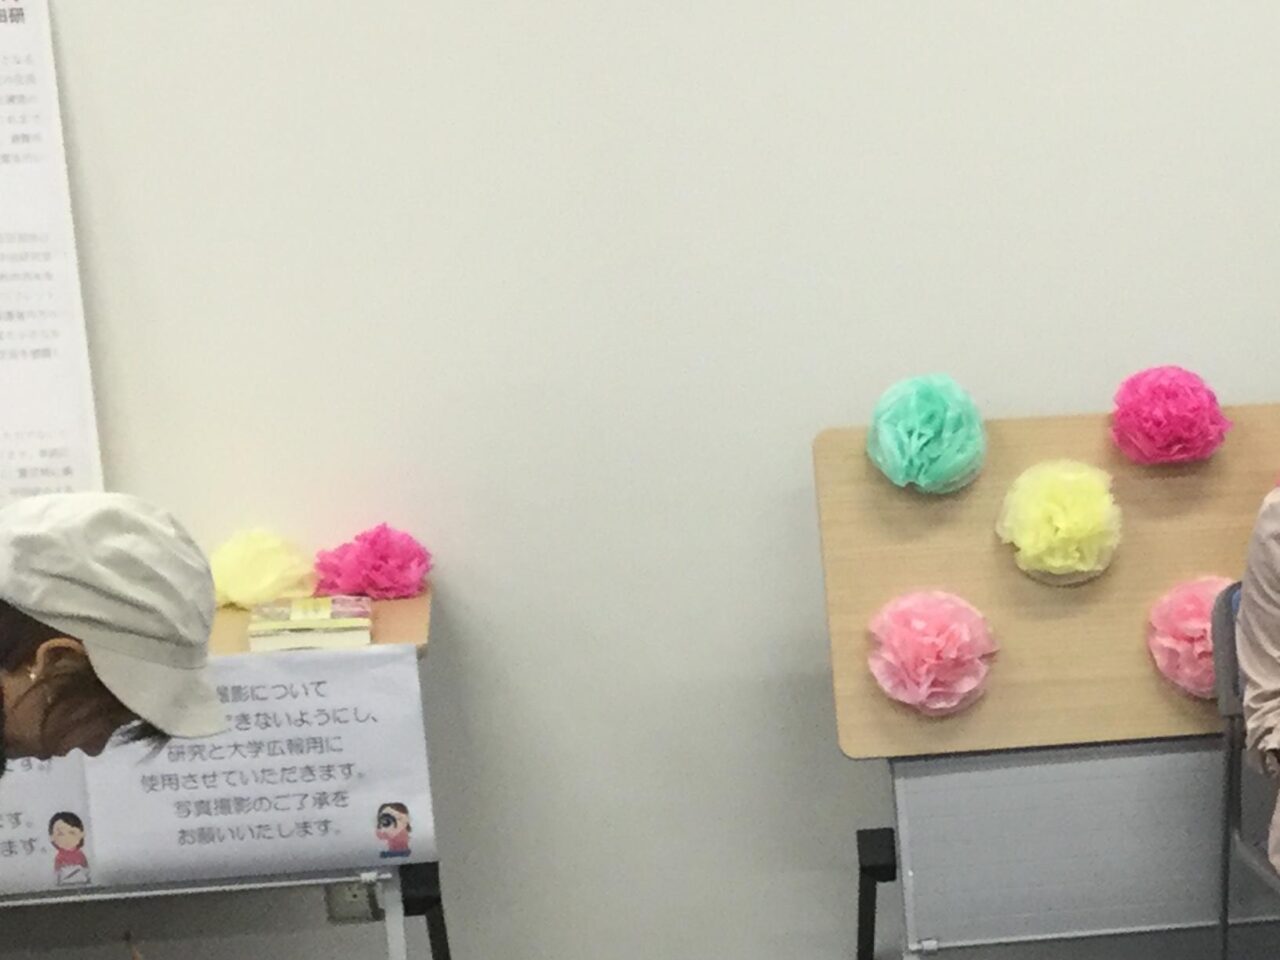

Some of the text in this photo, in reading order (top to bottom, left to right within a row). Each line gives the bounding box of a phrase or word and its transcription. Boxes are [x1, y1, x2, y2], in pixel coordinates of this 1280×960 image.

[167, 736, 344, 763] 研究と大学広報用に
[140, 762, 366, 794] 使用させていただきます。
[173, 790, 351, 818] 写真撮影のご了承を
[177, 818, 342, 846] お願いいたします。
